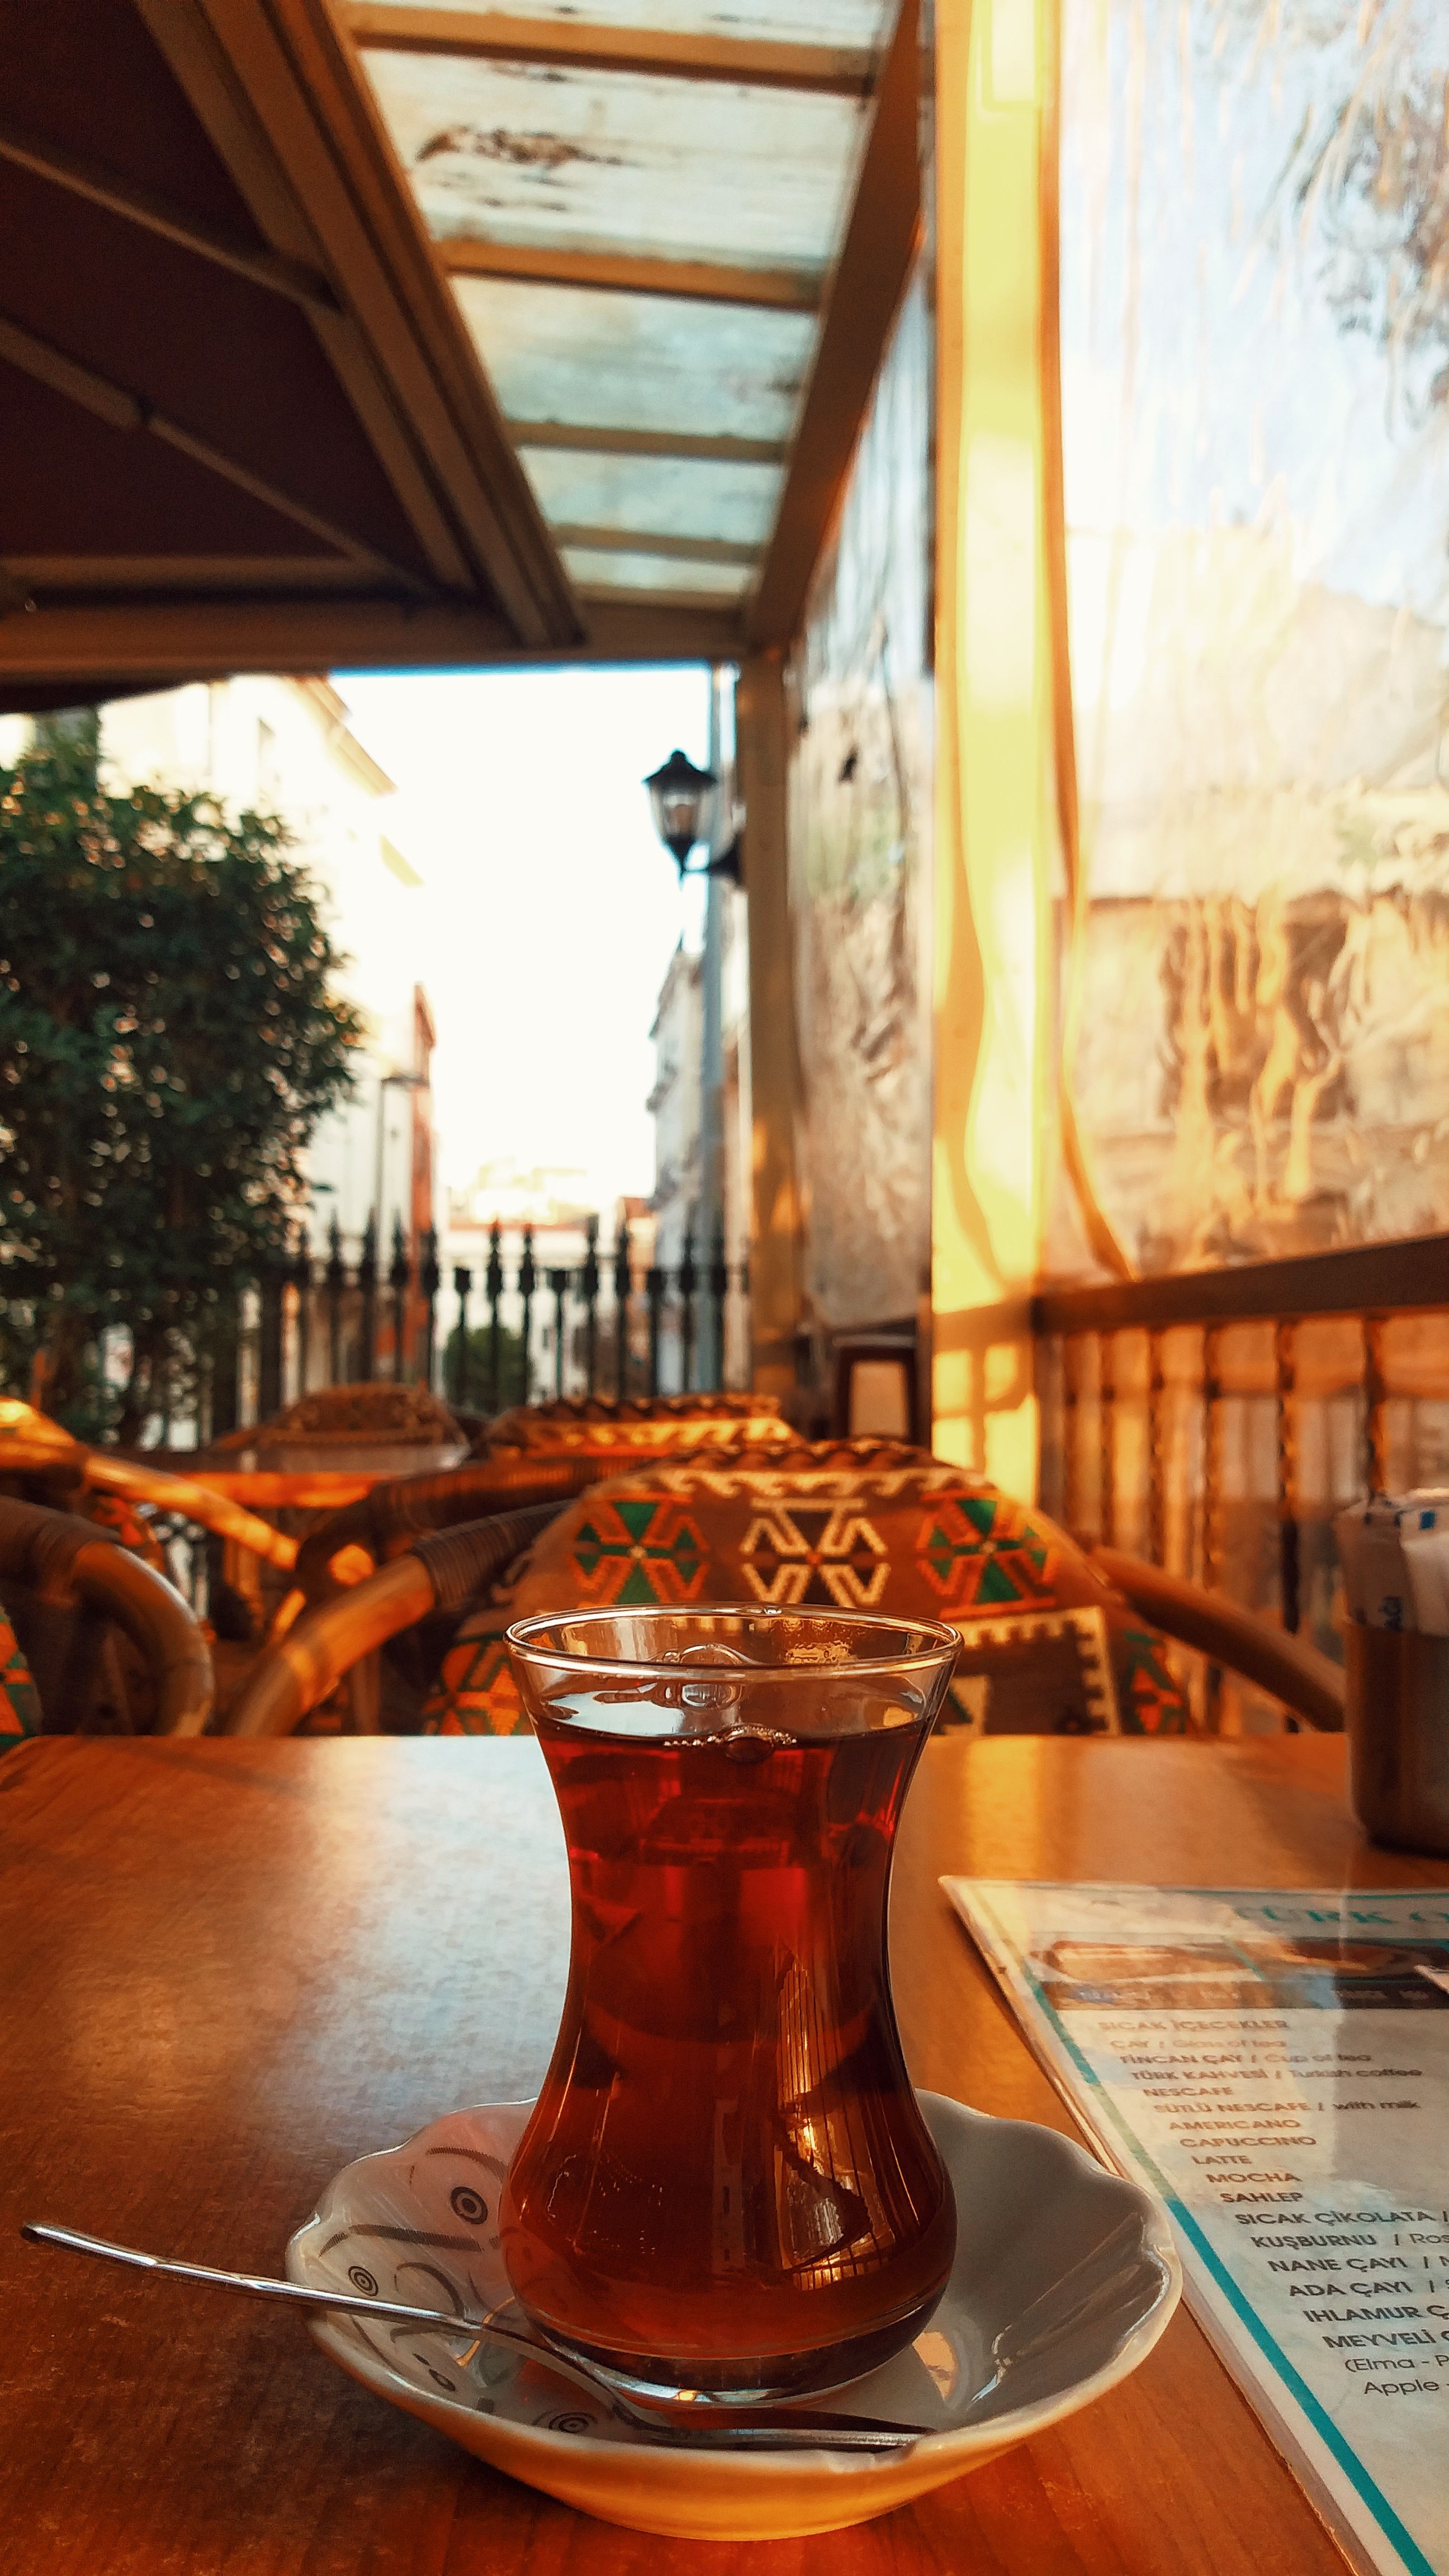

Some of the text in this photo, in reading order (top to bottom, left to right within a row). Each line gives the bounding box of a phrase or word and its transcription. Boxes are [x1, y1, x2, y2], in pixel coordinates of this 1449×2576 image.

[1143, 2086, 1234, 2096] NESCAFE
[1216, 2102, 1311, 2113] NESCAFE
[1169, 2119, 1301, 2130] AMERICANO
[1179, 2136, 1317, 2148] CAPUCCINO
[1191, 2155, 1253, 2165] LATTE
[1205, 2172, 1303, 2183] MOCHA
[1219, 2191, 1304, 2203] SAHLEP
[1234, 2213, 1311, 2225] SICAK
[1314, 2210, 1437, 2227] ÇİKOLATA
[1249, 2234, 1377, 2251] KUŞBURNU
[1267, 2258, 1343, 2272] NANE
[1346, 2256, 1408, 2274] ÇAYI
[1289, 2283, 1347, 2297] ADA
[1349, 2281, 1413, 2298] ÇAYI
[1302, 2305, 1424, 2323] IHLAMUR
[1322, 2328, 1437, 2348] MEYVELİ
[1344, 2357, 1415, 2373] (Elma
[1363, 2379, 1440, 2397] Apple
